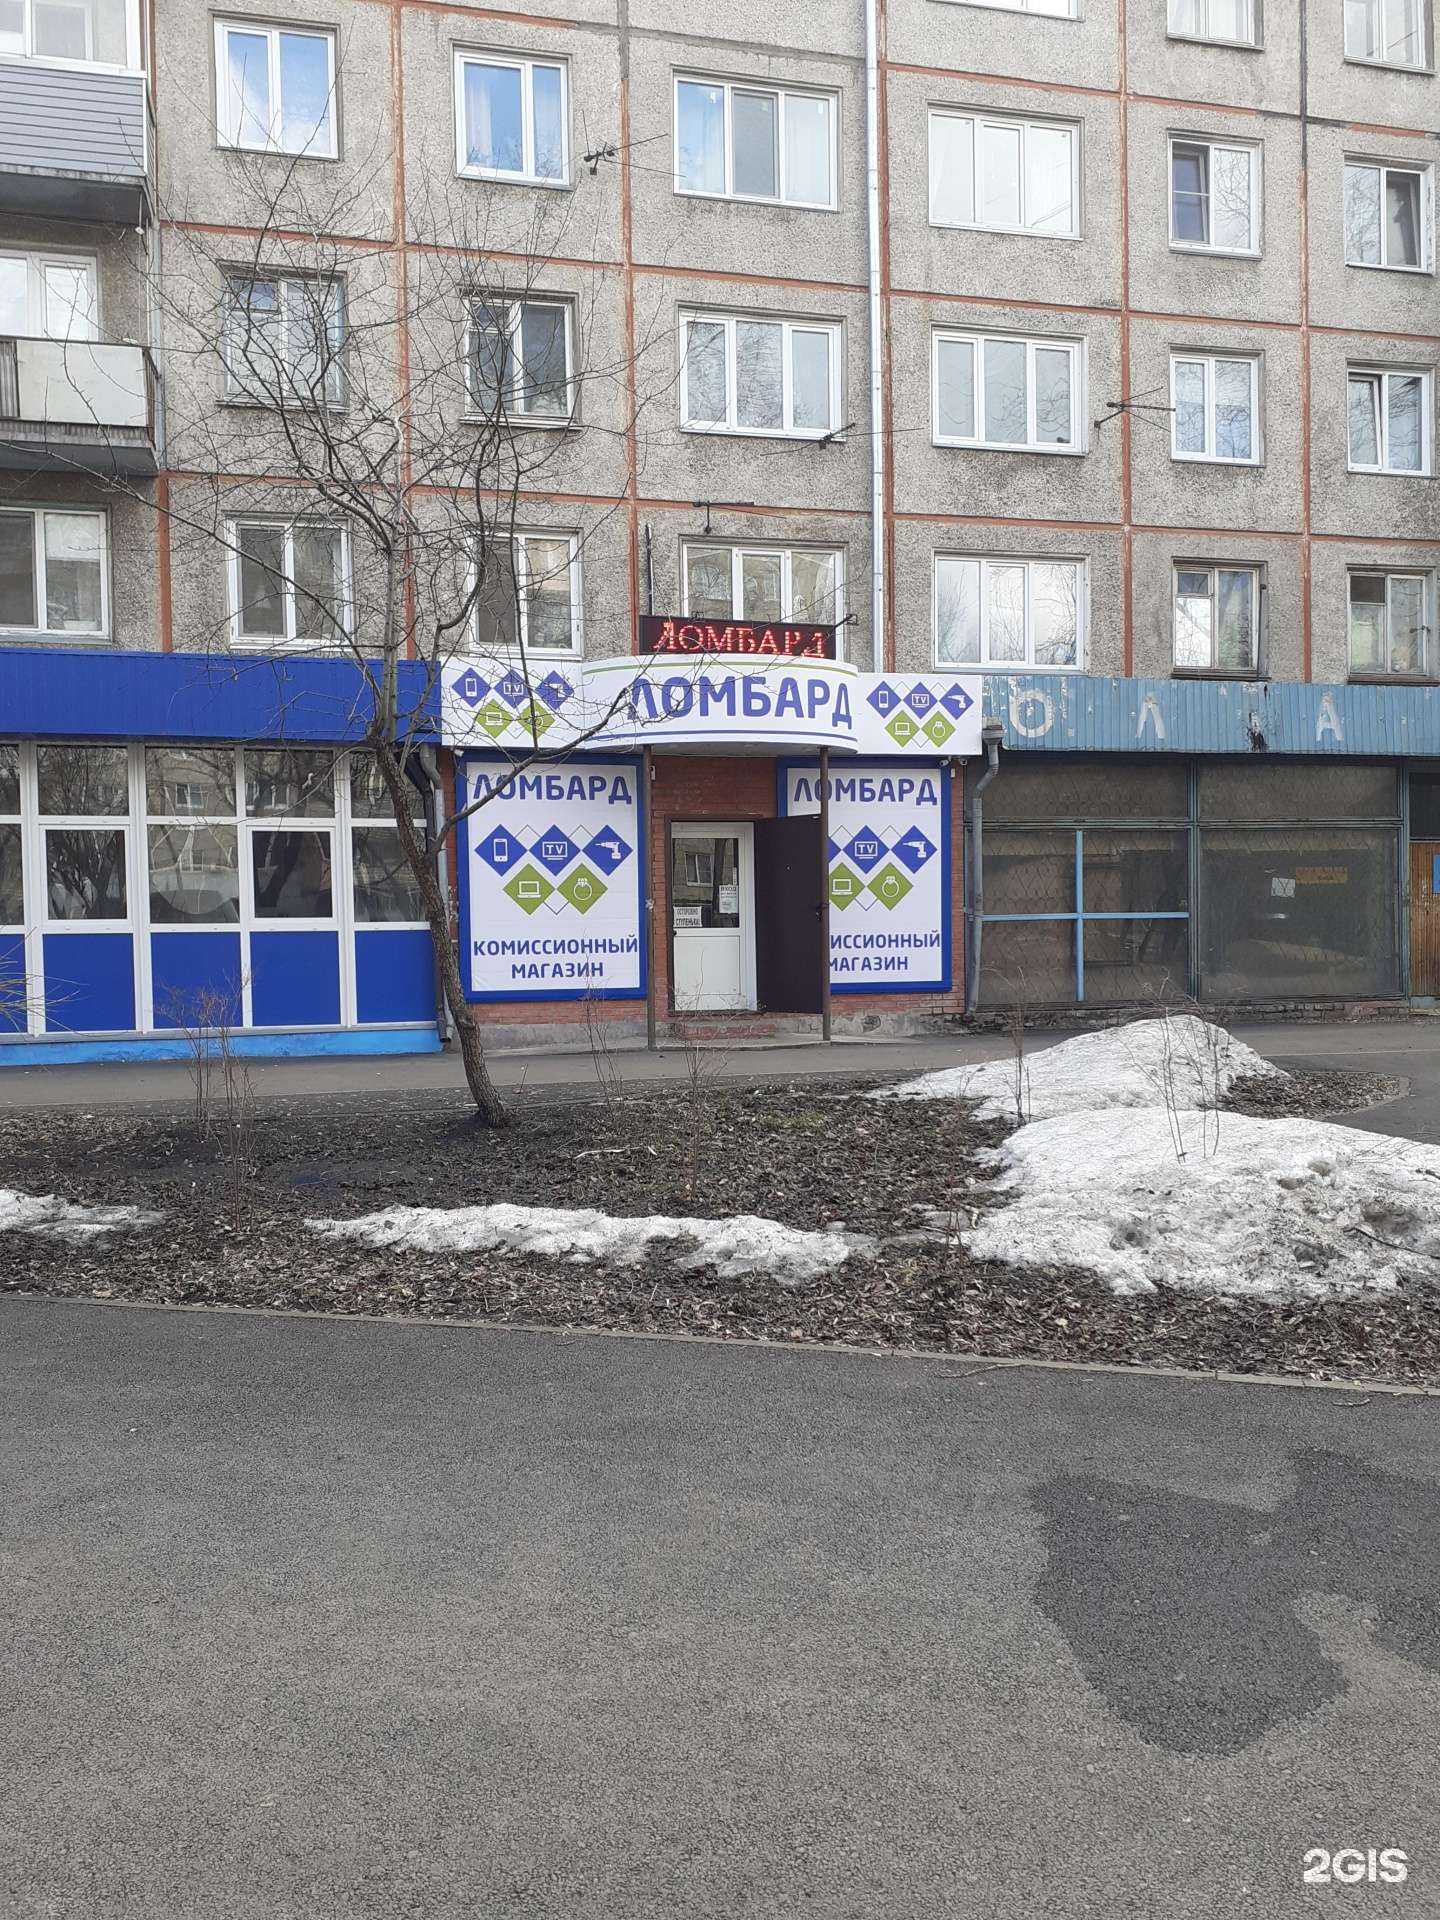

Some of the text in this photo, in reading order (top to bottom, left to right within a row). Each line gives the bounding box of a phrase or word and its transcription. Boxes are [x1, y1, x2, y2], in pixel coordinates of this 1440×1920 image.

[653, 621, 825, 658] ЛОМБАРД
[626, 675, 853, 730] ЛОМБАРД
[473, 773, 632, 805] ЛОМБАРД
[793, 777, 938, 806] ЛОМБАРД
[546, 844, 564, 854] TV
[858, 844, 874, 853] TV
[473, 934, 638, 956] КОМИССИОННЫЙ
[511, 962, 604, 979] МАГАЗИН
